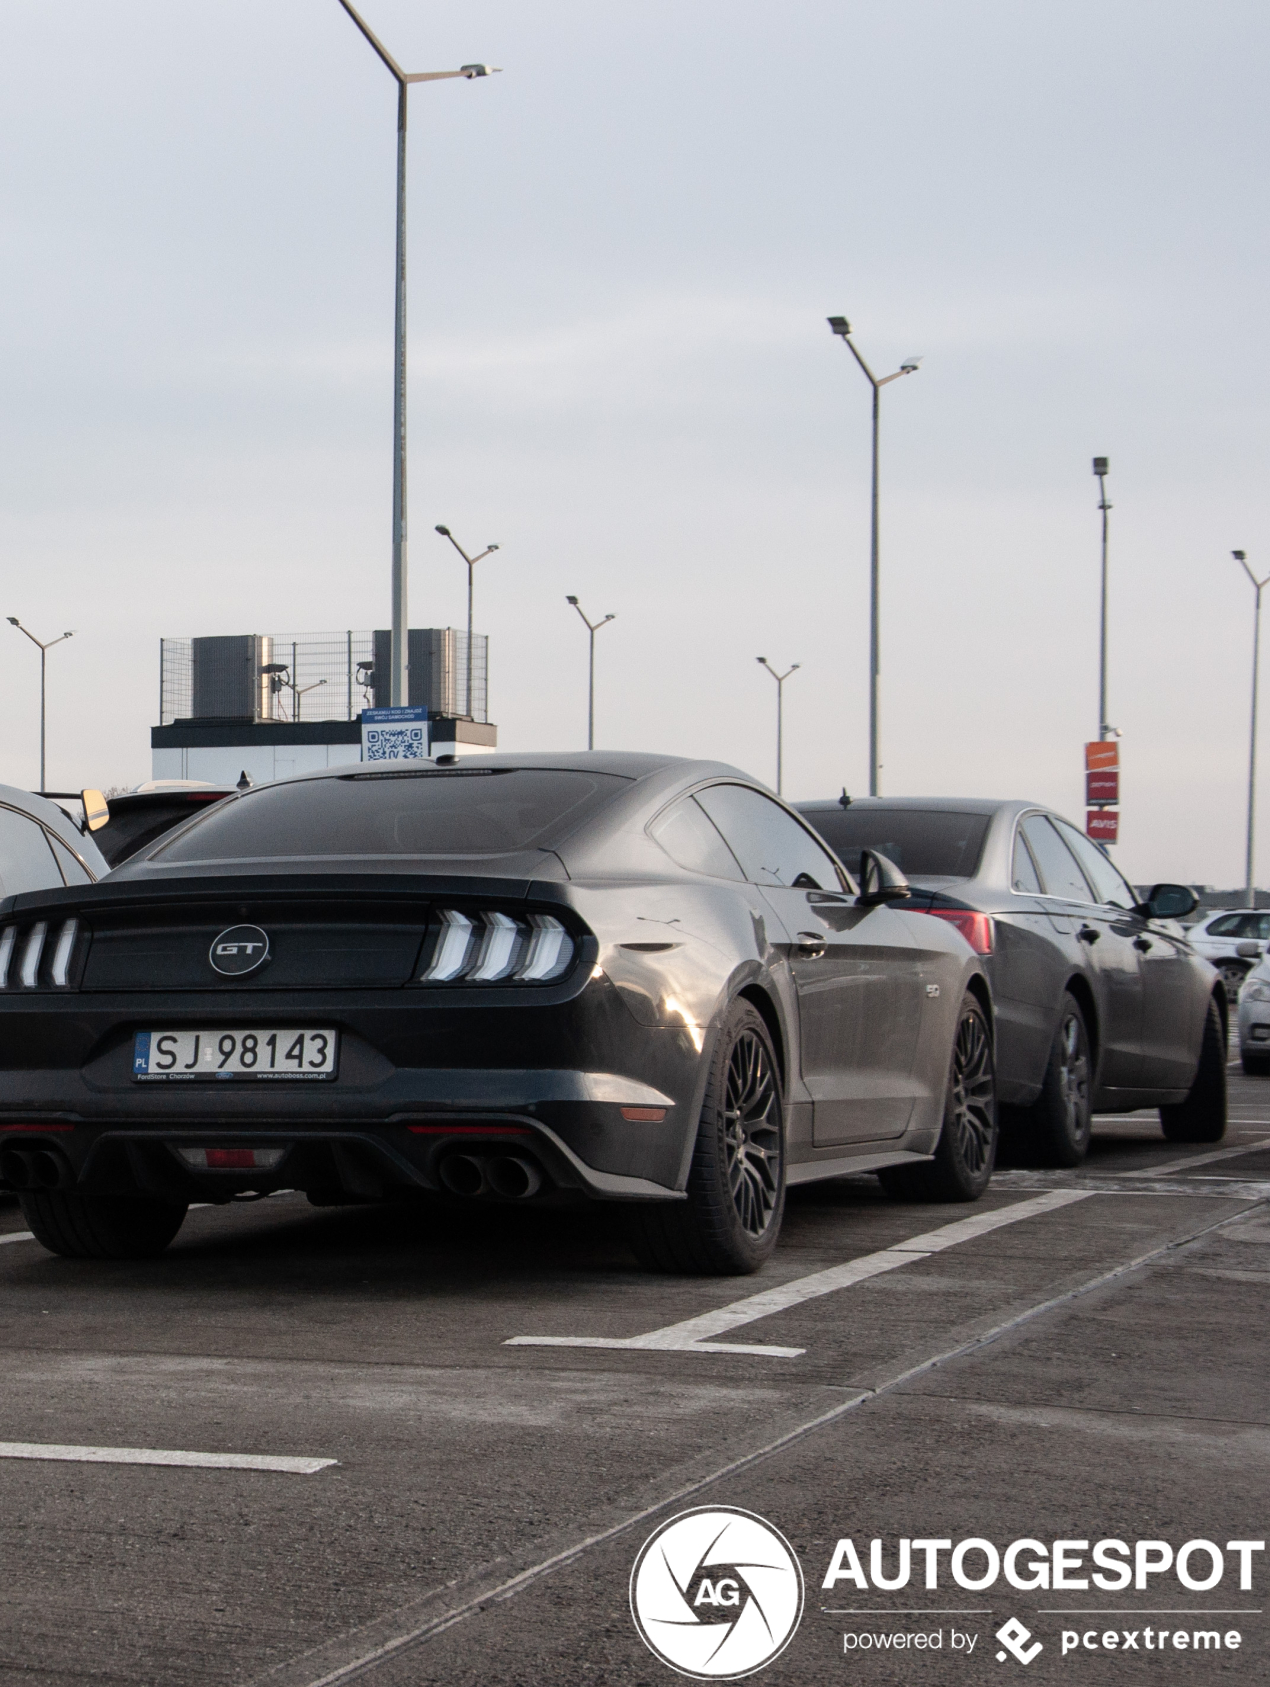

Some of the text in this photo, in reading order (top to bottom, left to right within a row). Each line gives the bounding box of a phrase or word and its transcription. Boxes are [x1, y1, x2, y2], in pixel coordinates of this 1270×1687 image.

[215, 942, 264, 955] GT
[155, 1033, 329, 1070] SJ 98143
[135, 1058, 147, 1068] PL
[257, 1072, 327, 1080] www.autoboss.com.pl
